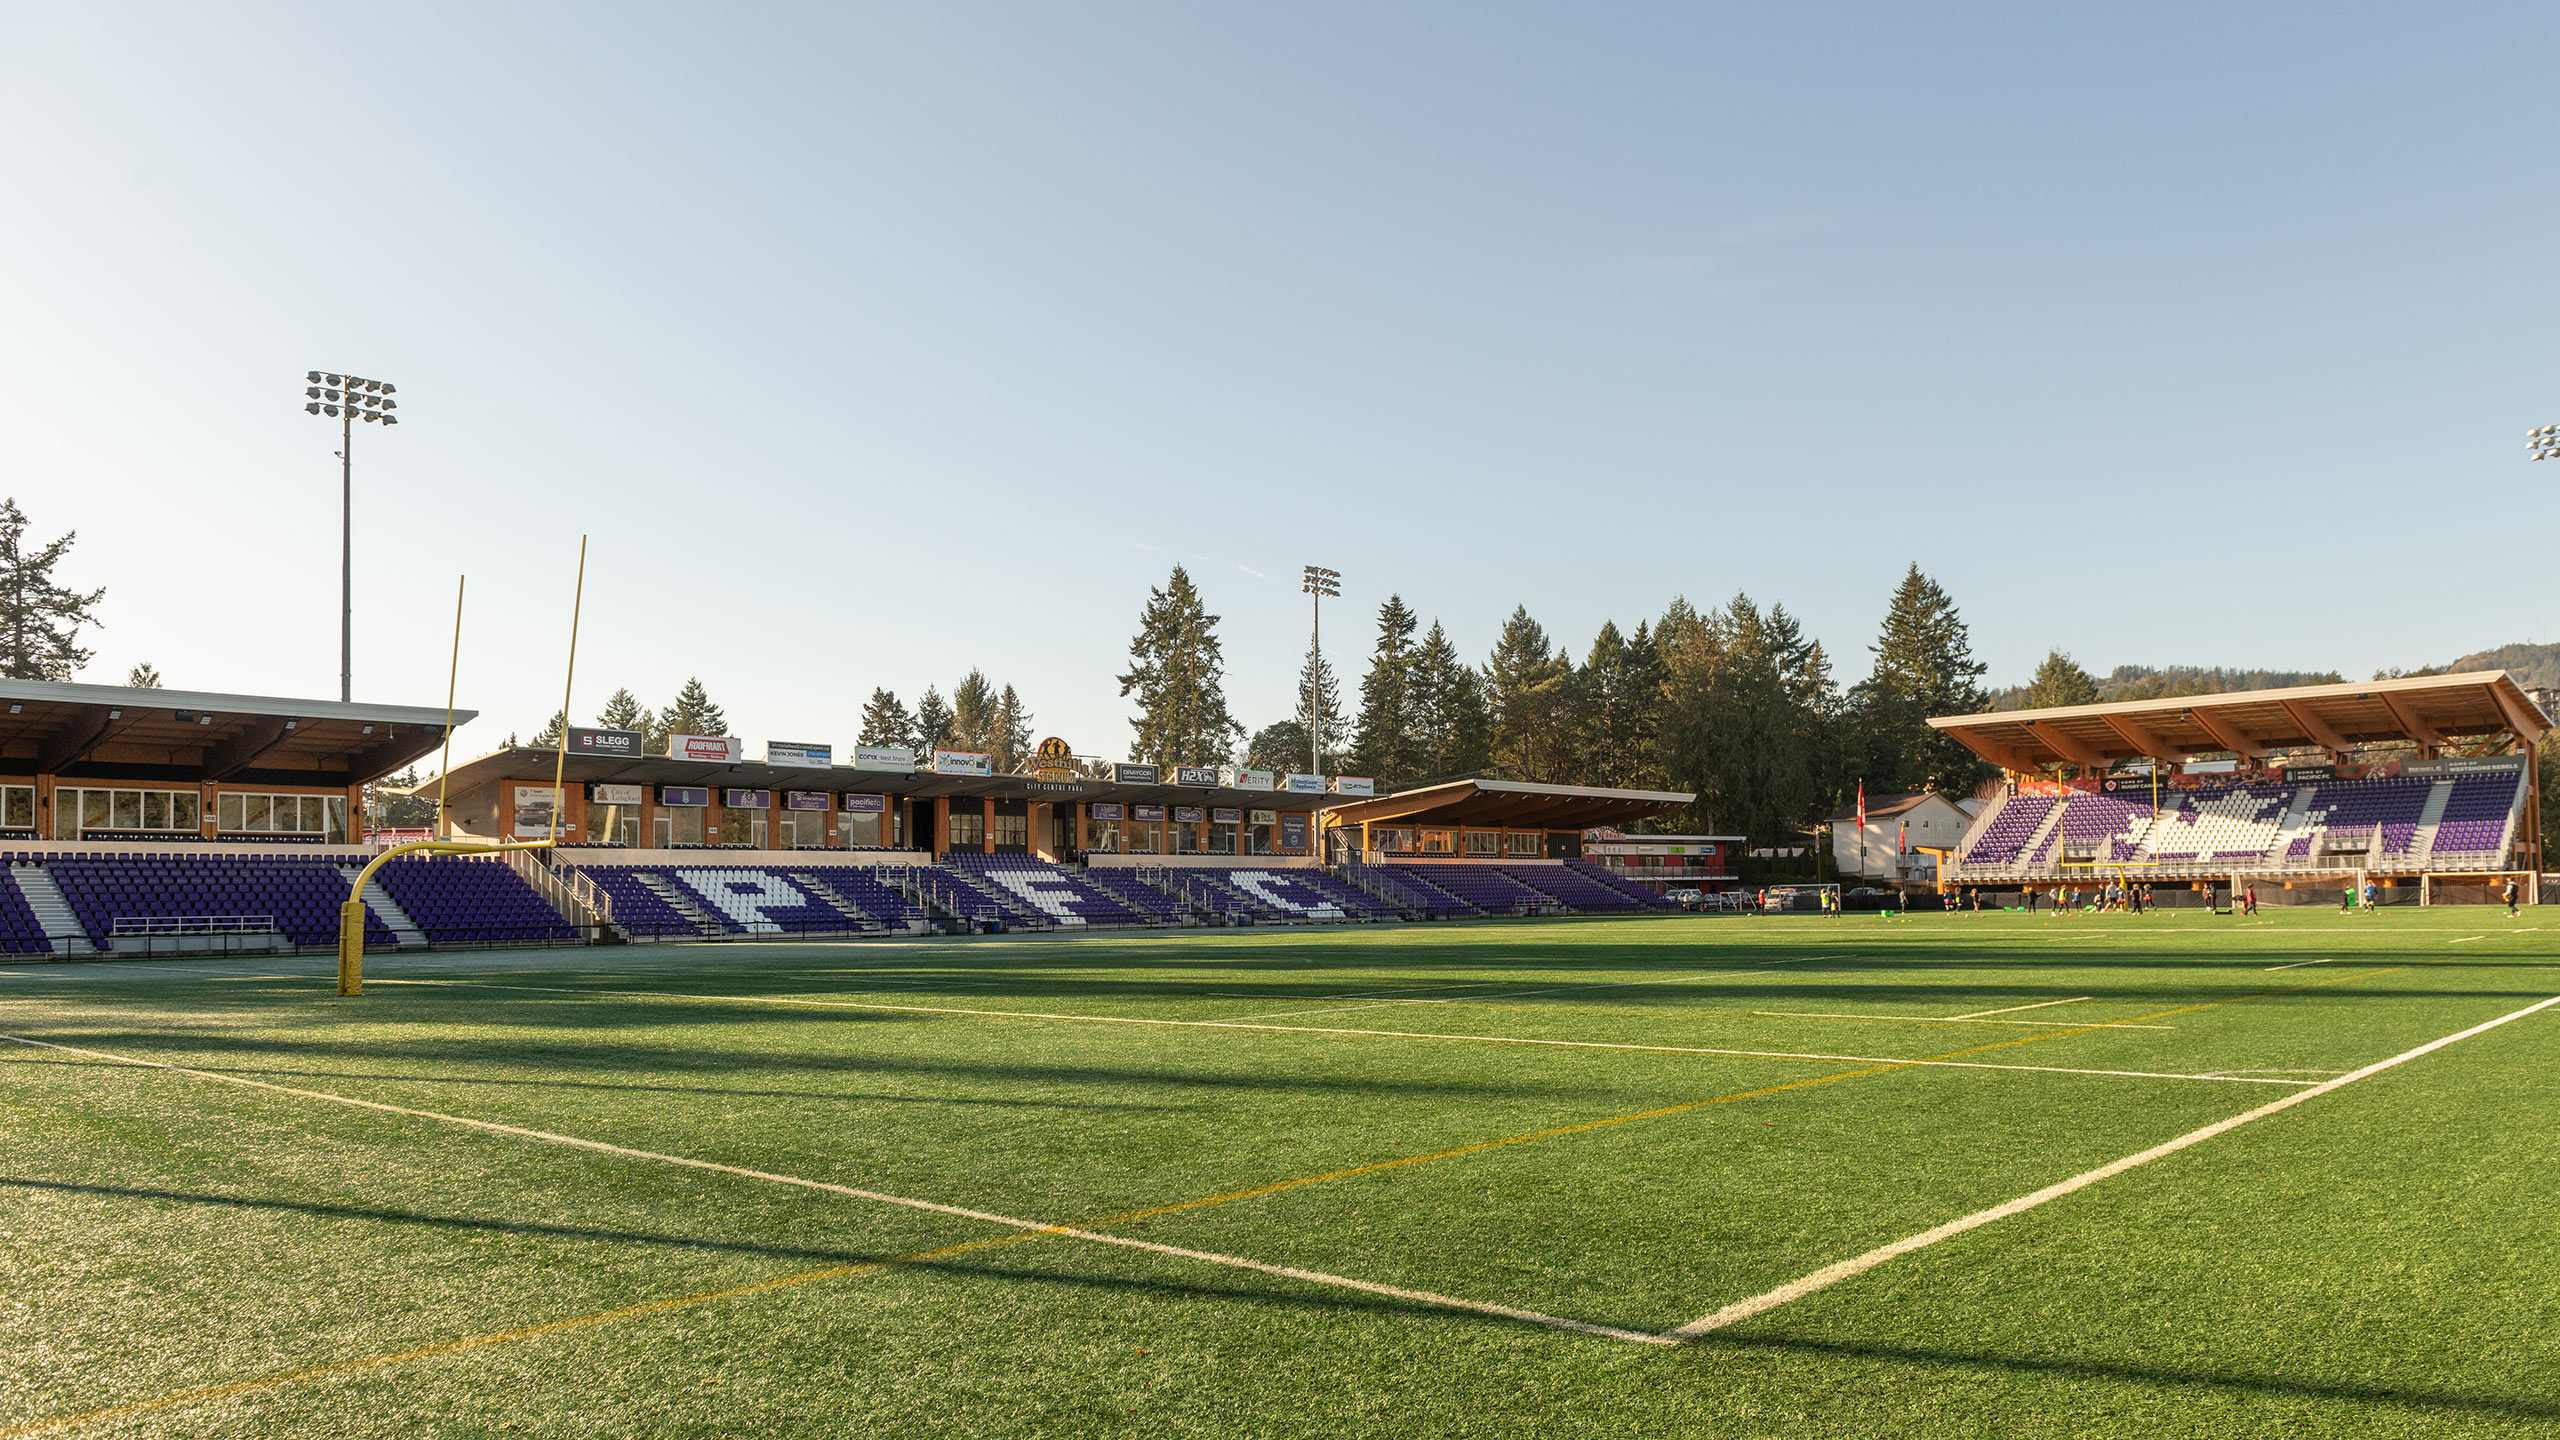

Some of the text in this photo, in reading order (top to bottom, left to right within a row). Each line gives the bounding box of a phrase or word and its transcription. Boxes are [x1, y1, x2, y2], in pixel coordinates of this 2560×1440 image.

[596, 736, 629, 745] SLEGG
[688, 740, 726, 752] ROOFMART
[950, 755, 975, 766] innov8
[1024, 758, 1090, 777] Westhills
[1038, 771, 1076, 784] STADIUM
[1182, 770, 1203, 782] H2X
[1240, 774, 1270, 784] VERITY
